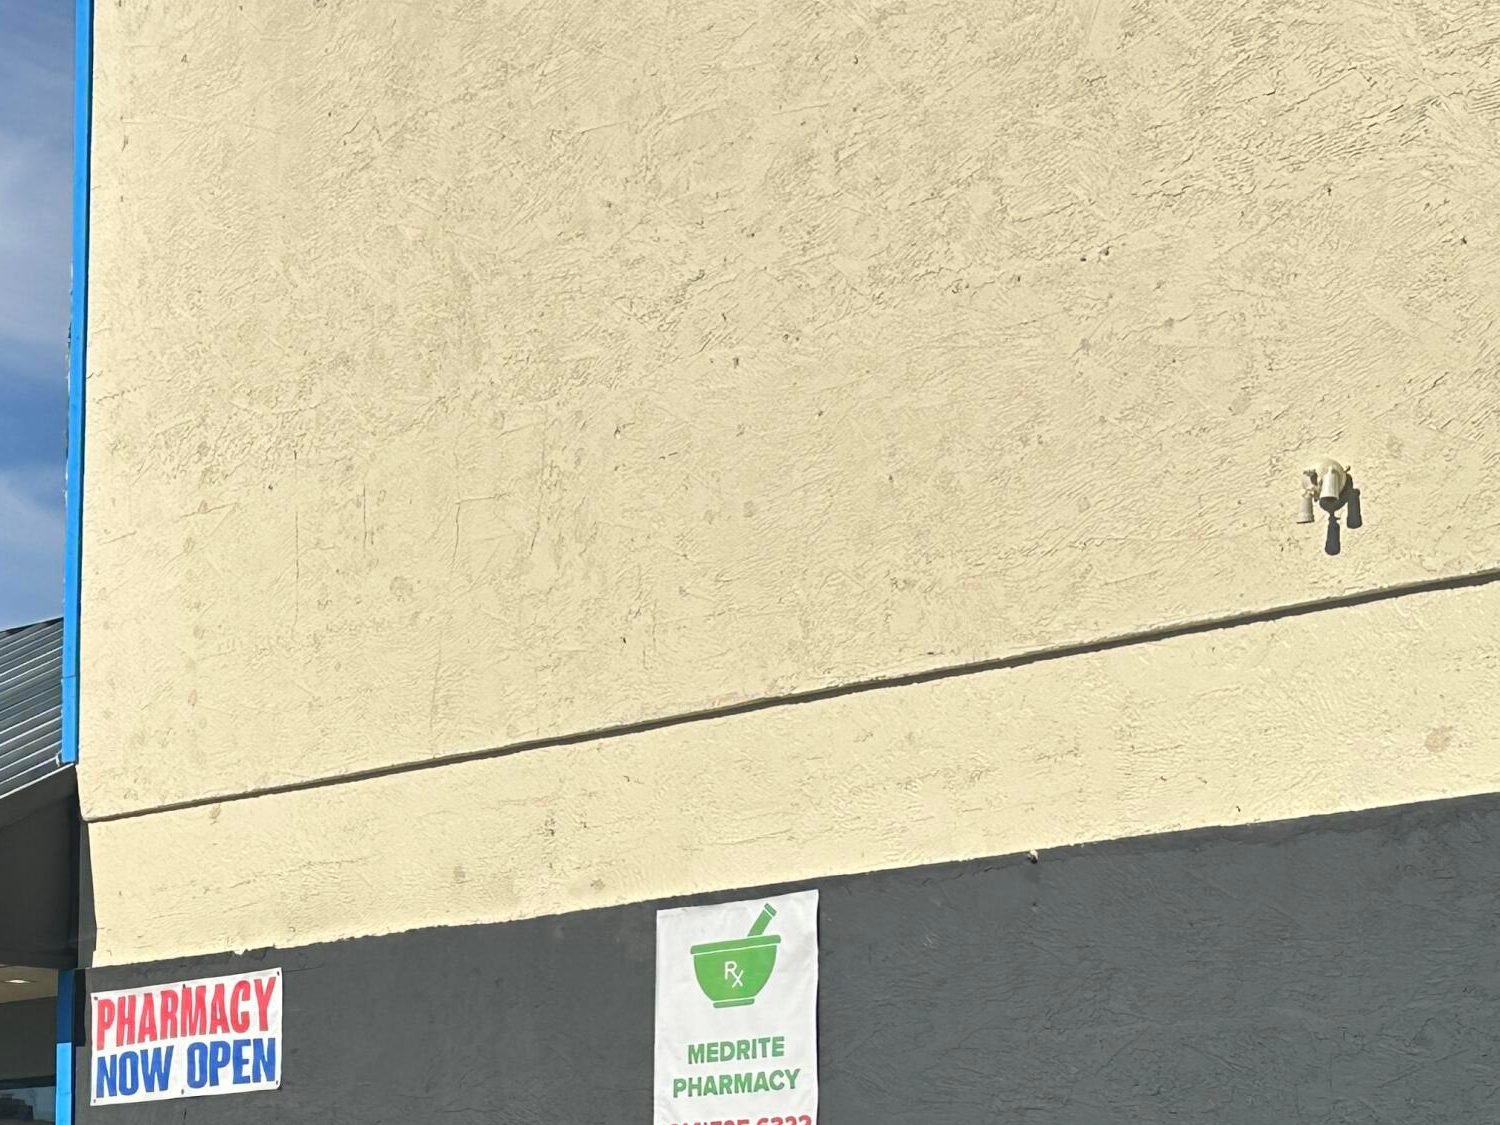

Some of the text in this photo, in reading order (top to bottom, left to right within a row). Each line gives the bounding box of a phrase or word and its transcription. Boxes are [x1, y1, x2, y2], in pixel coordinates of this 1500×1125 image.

[96, 976, 277, 1051] PHARMACY
[96, 1037, 276, 1098] NOW OPEN
[687, 1035, 785, 1065] MEDRITE
[672, 1068, 801, 1098] PHARMACY
